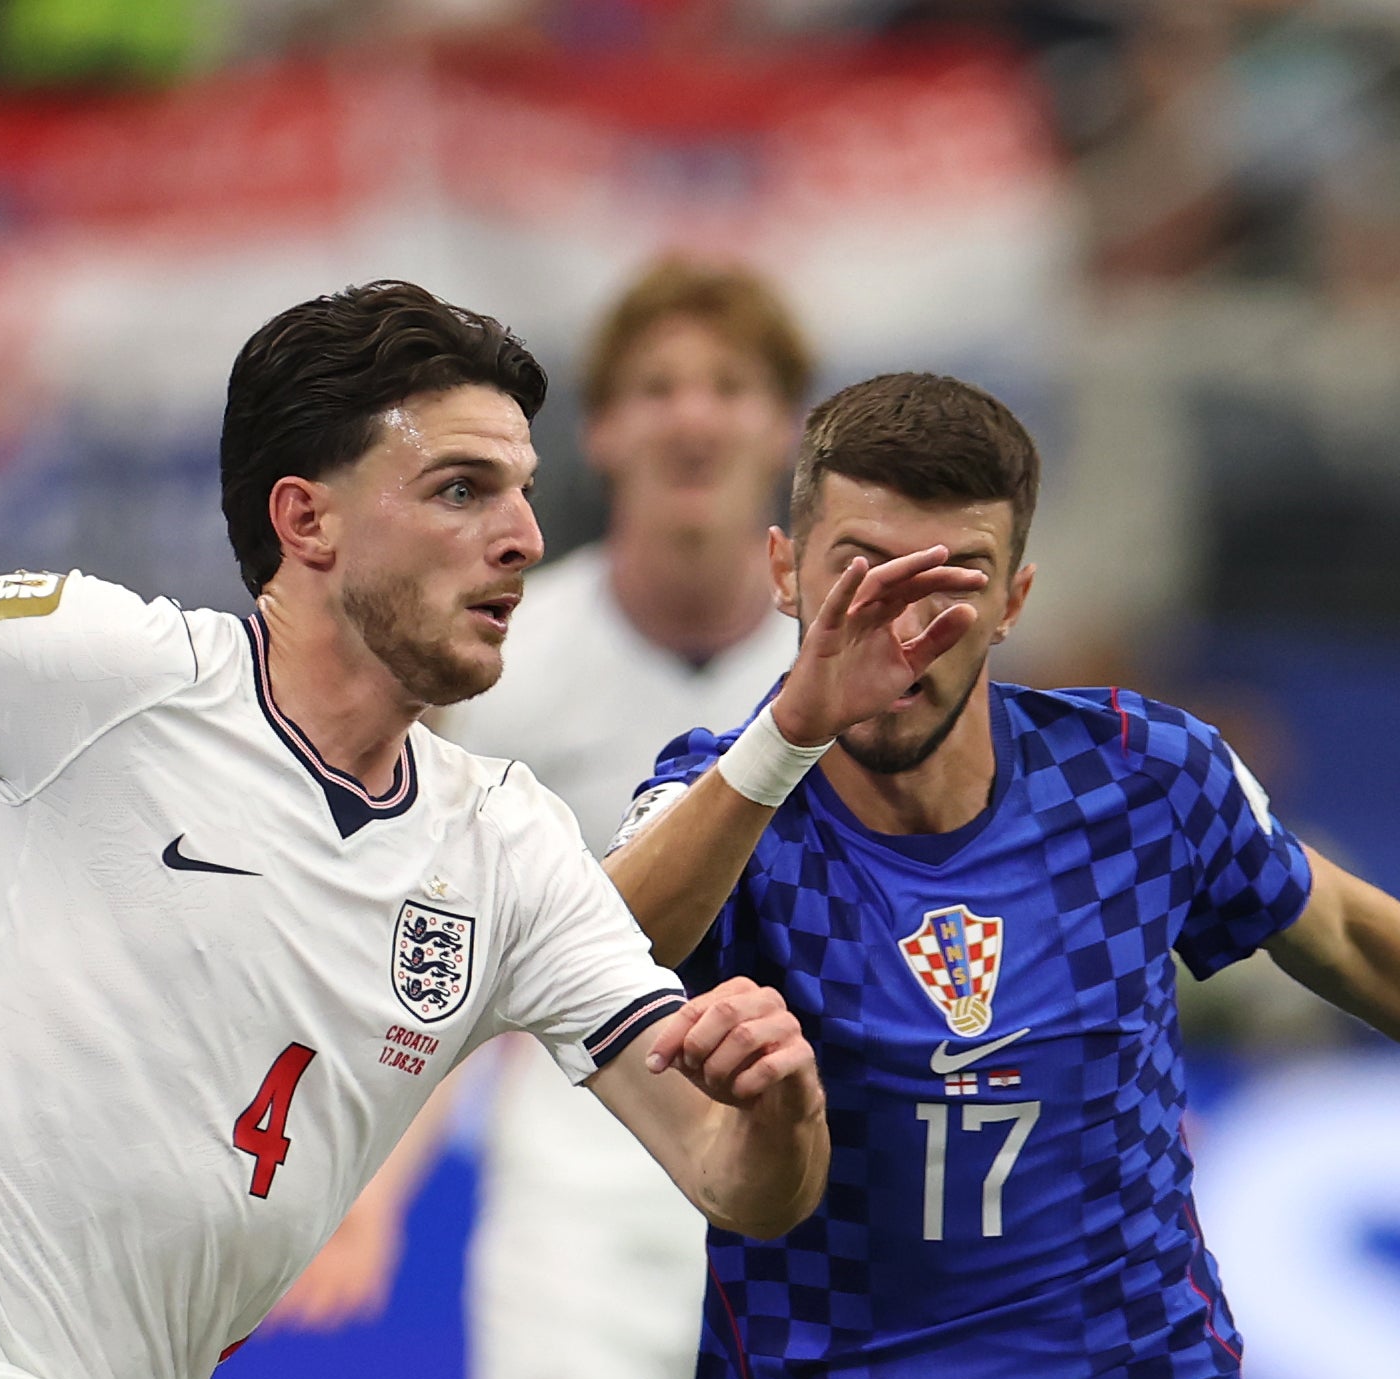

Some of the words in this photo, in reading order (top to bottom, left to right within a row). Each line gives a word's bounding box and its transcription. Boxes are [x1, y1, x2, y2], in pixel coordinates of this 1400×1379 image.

[940, 920, 967, 985] HNS
[378, 1046, 426, 1076] 17.06.26
[385, 1025, 439, 1055] CROATIA
[233, 1042, 317, 1199] 4
[916, 1100, 1041, 1241] 17
